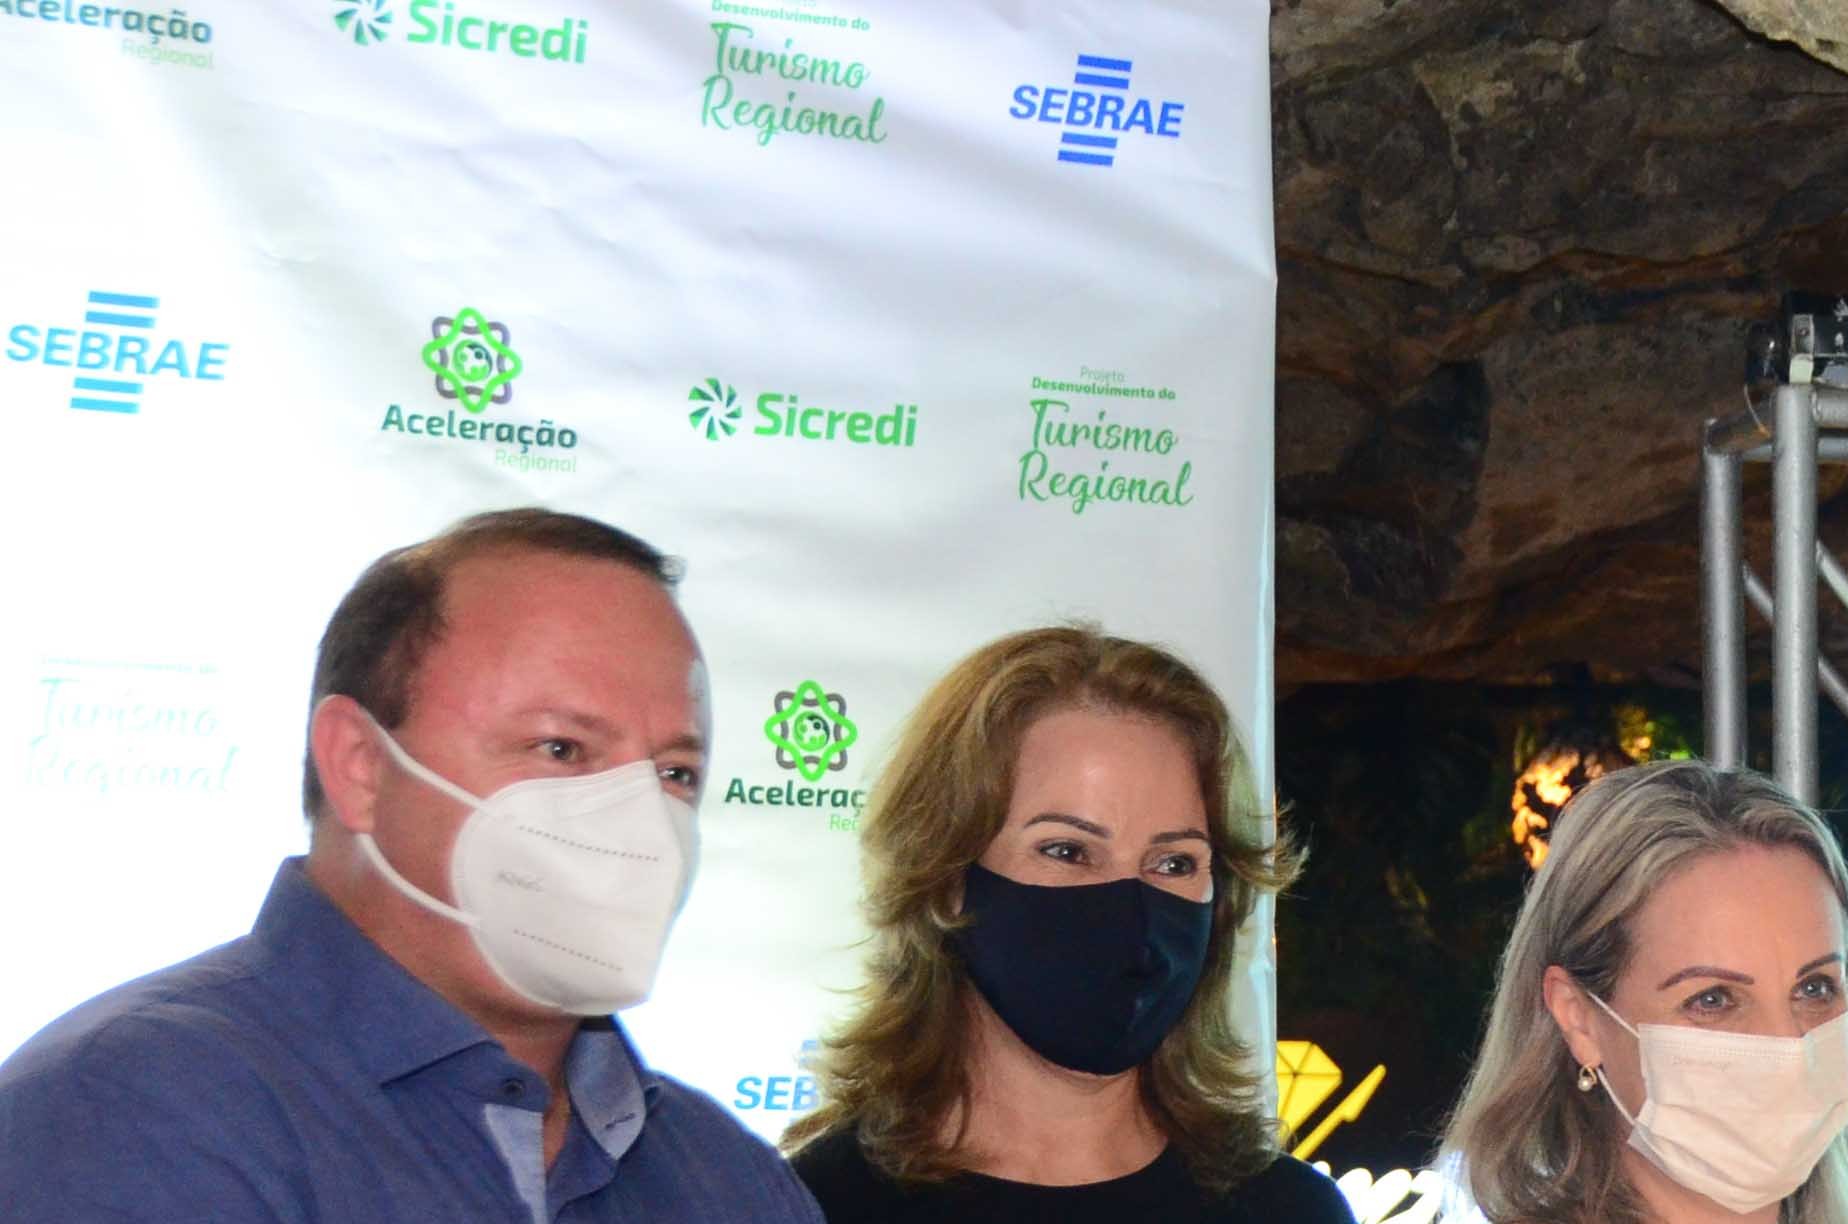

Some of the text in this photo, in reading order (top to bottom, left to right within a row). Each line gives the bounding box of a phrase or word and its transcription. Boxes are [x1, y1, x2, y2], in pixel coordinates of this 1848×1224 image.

[407, 0, 588, 63] Sicredi
[712, 0, 871, 31] Desenvolvimento do
[709, 22, 872, 88] Turismo
[702, 74, 888, 146] Regional
[1009, 84, 1185, 138] SEBRAE
[6, 324, 231, 380] SEBRAE
[1080, 365, 1126, 383] Projeto
[1032, 377, 1176, 400] Desenvolvimento do
[381, 404, 578, 453] Aceleração
[754, 393, 918, 447] Sicredi
[1029, 399, 1179, 455] Turismo
[495, 449, 577, 473] Regional
[1019, 449, 1194, 515] Regional
[724, 778, 867, 817] Aceleraç
[734, 1076, 819, 1110] SEB
